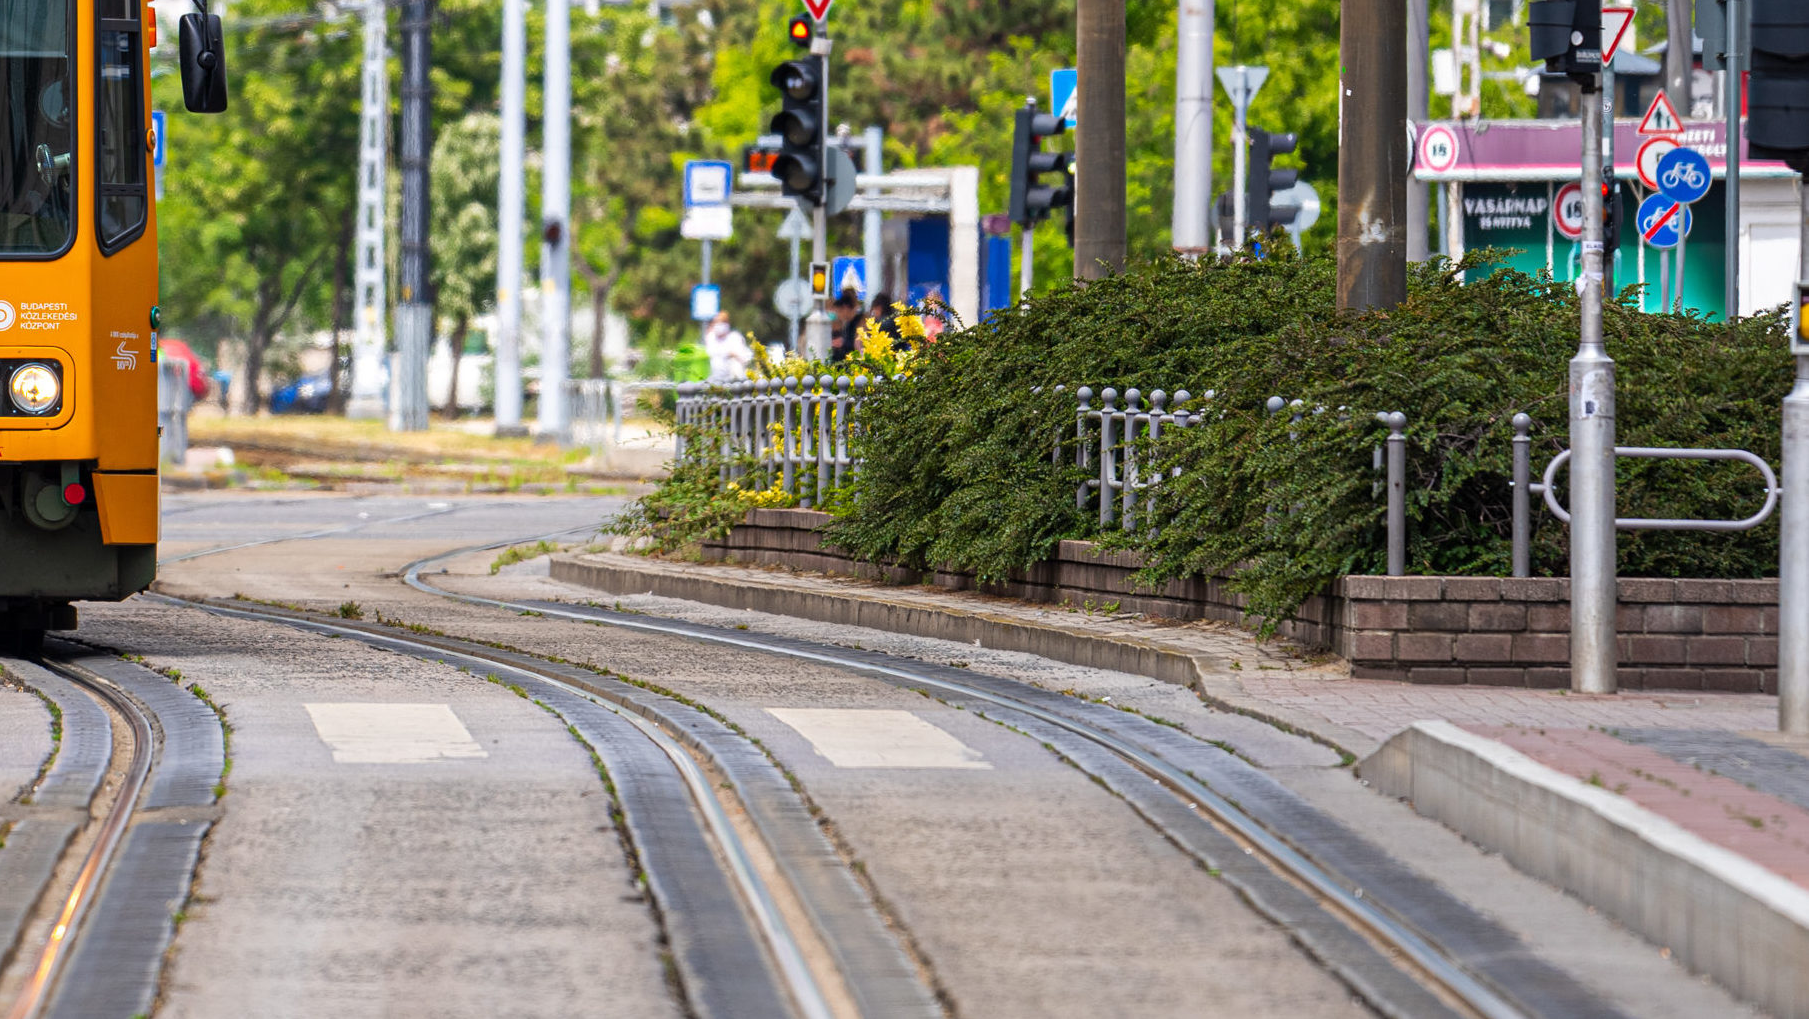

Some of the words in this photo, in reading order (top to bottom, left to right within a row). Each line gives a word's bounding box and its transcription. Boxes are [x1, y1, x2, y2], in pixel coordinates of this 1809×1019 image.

[20, 303, 67, 311] BUDAPESTI
[20, 311, 78, 321] KÖZLEKEDÉSI
[20, 321, 60, 330] KÖZPONT
